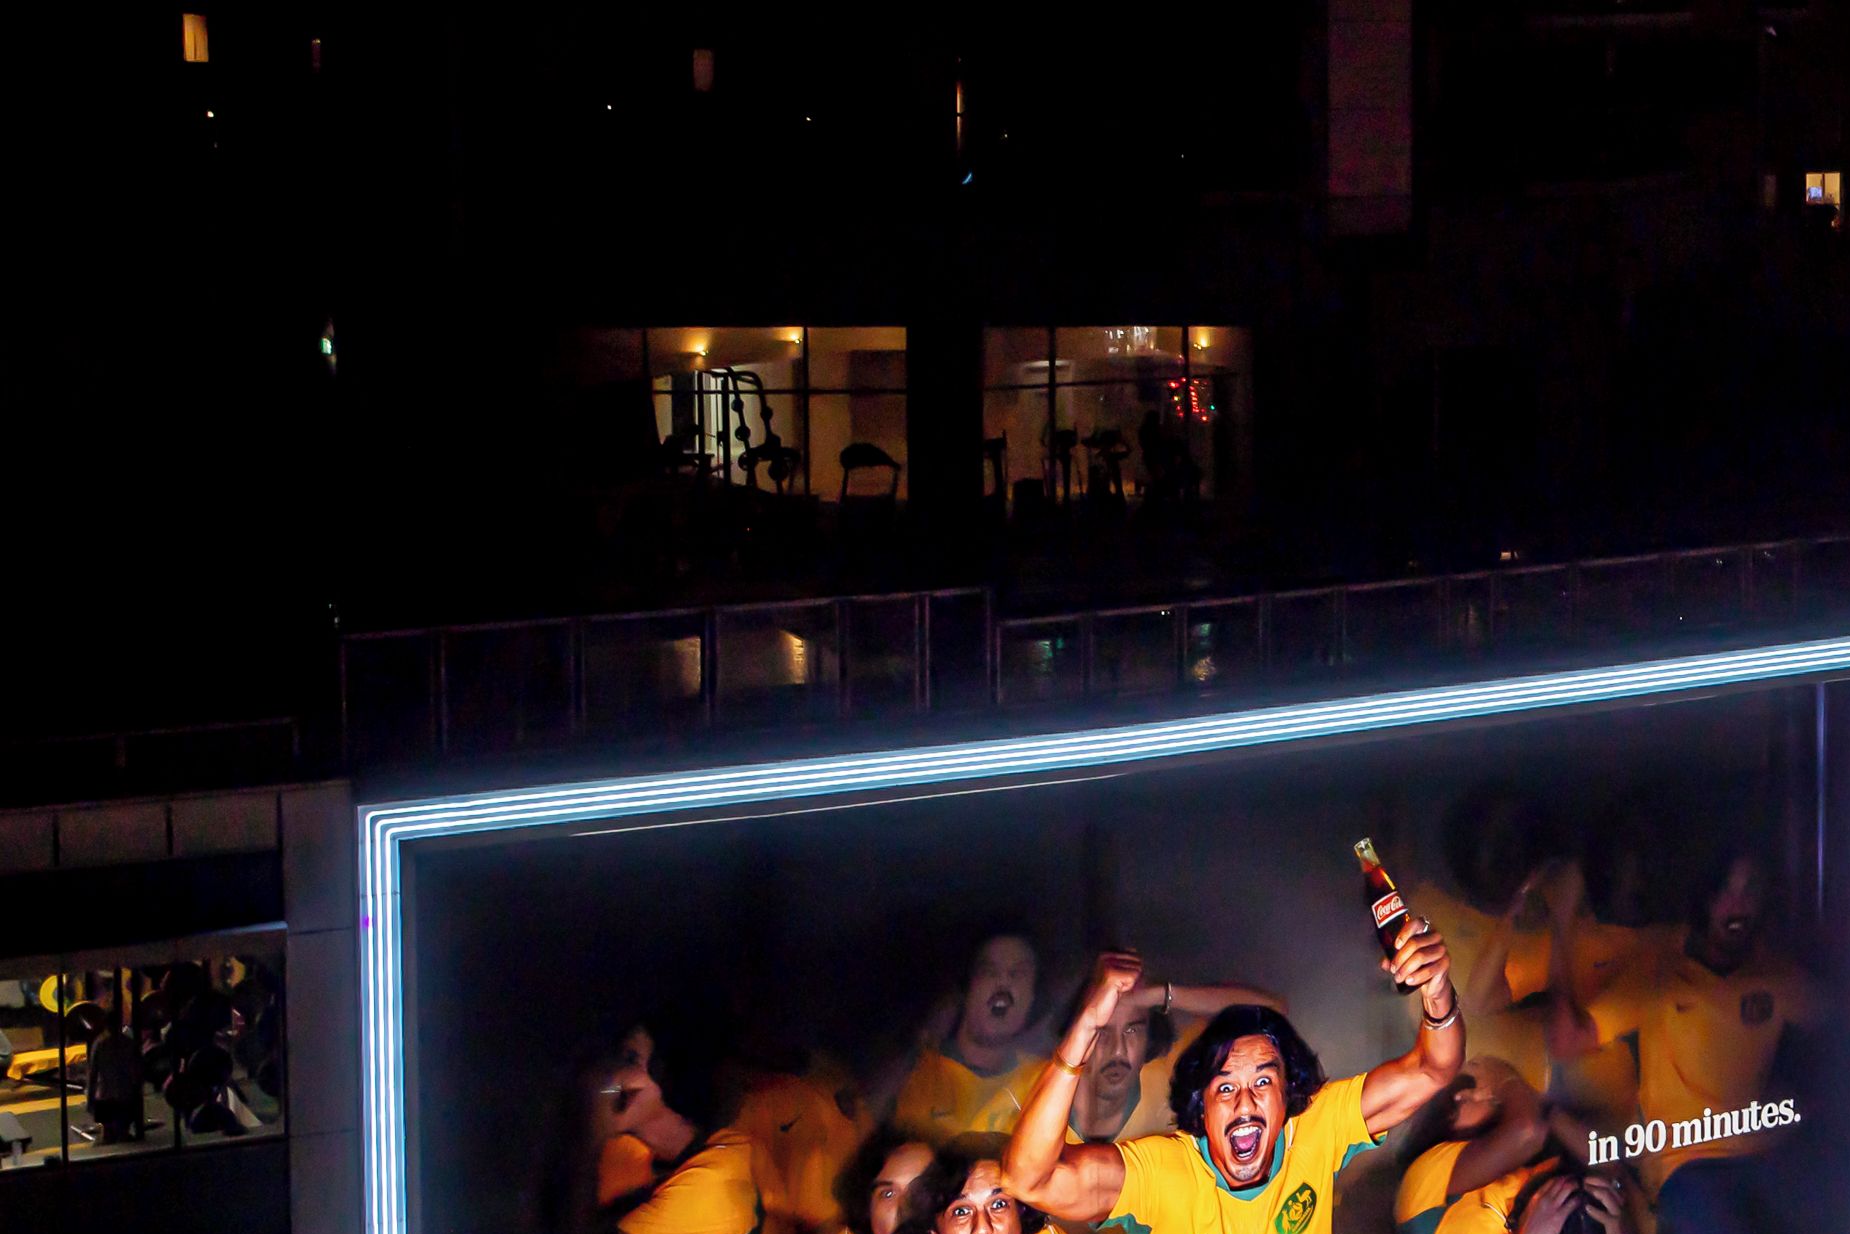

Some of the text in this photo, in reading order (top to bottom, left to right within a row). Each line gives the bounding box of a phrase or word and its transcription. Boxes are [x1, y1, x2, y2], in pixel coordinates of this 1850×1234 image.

[1588, 1099, 1801, 1165] in 90 minutes.
